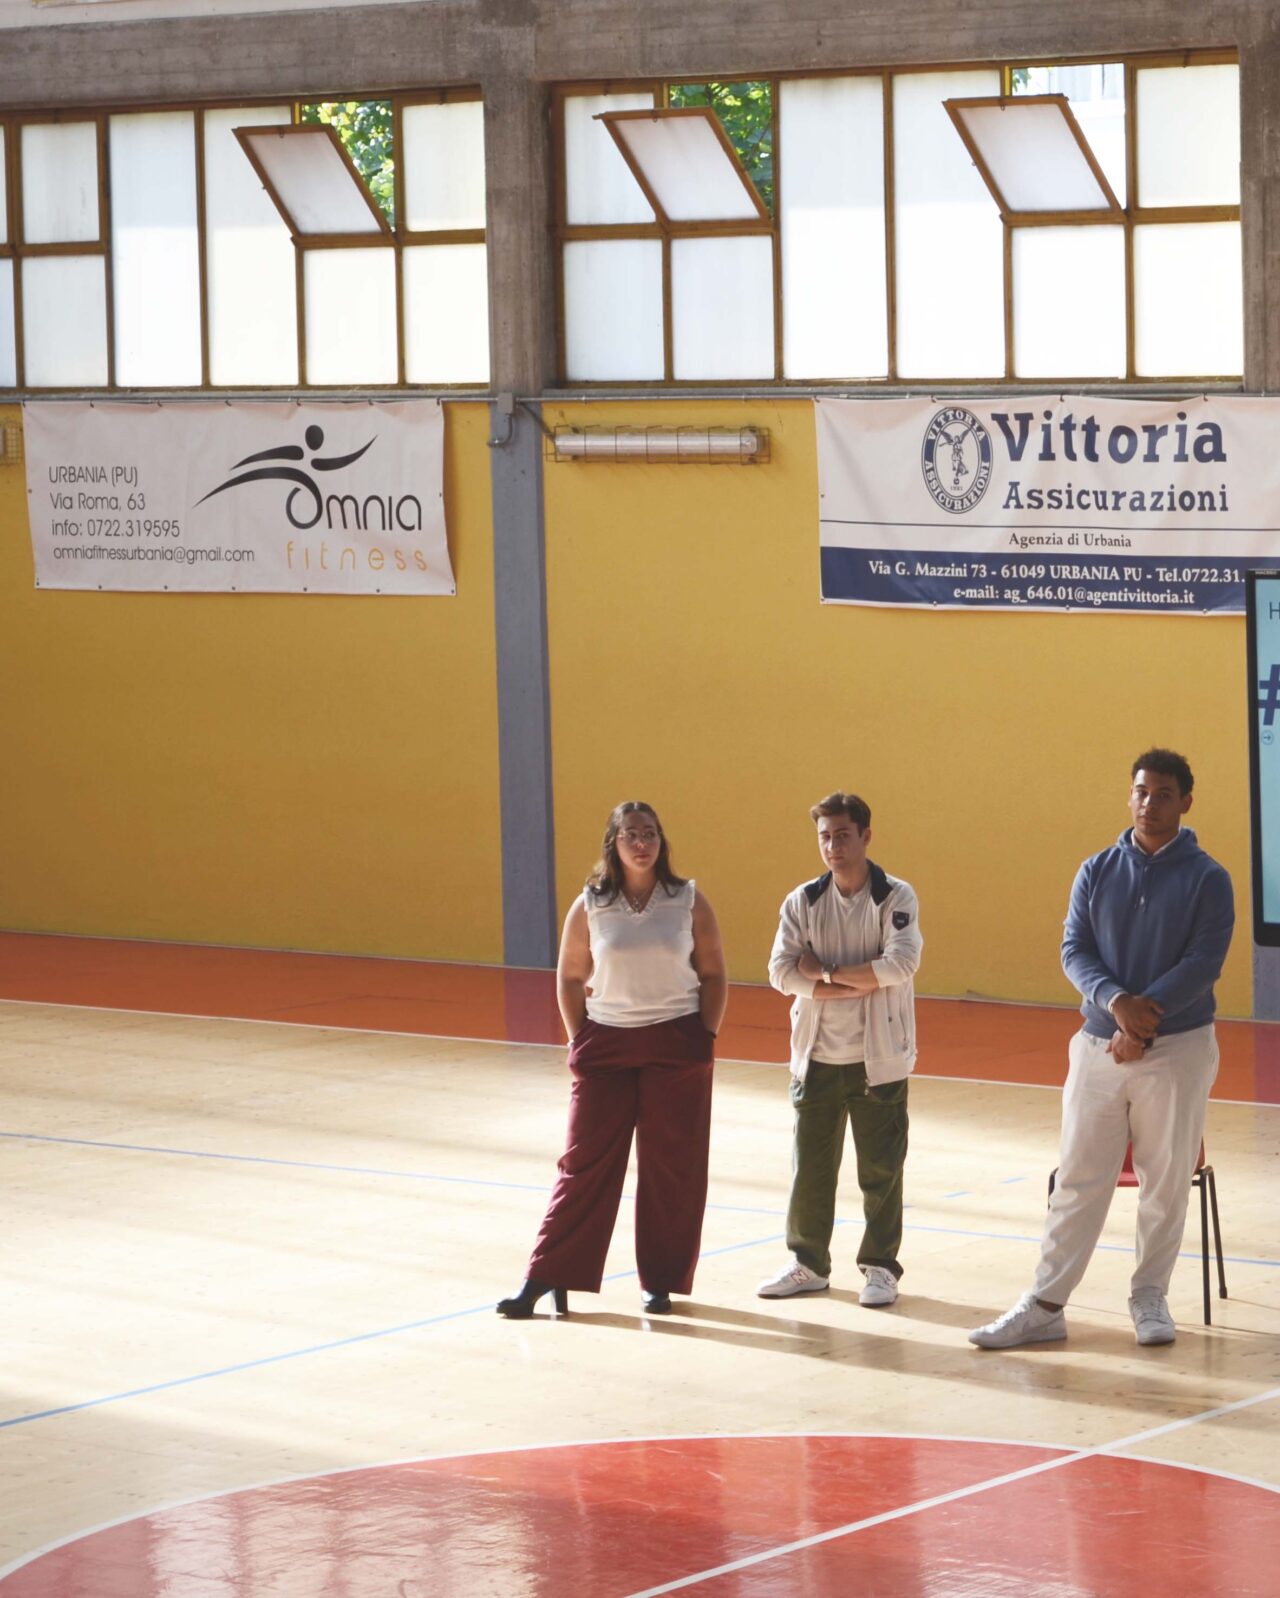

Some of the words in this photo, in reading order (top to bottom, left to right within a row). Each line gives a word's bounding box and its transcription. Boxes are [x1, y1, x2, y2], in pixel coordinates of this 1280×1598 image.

[928, 410, 986, 440] VITTORIA
[990, 409, 1227, 465] Vittoria
[48, 466, 108, 484] URBANIA
[111, 466, 138, 487] (PU)
[925, 461, 990, 510] ASSICURAZIONI
[50, 493, 73, 510] Via
[78, 493, 122, 512] Roma,
[127, 493, 146, 510] 63
[1002, 480, 1229, 513] Assicurazioni
[52, 519, 83, 537] info:
[87, 519, 180, 538] 0722.319595
[1009, 533, 1063, 549] Agenzia
[1067, 533, 1079, 546] di
[1084, 533, 1132, 548] Urbania
[53, 545, 255, 564] omniafitnessurbania@gmail.com
[287, 541, 428, 571] fitness
[869, 561, 891, 575] Via
[895, 562, 910, 576] G.
[915, 563, 968, 578] Mazzini
[971, 565, 987, 578] 73
[1001, 564, 1046, 579] 61049
[1050, 565, 1120, 581] URBANIA
[1123, 567, 1142, 582] PU
[953, 585, 999, 599] e-mail:
[1004, 585, 1196, 605] ag_646.01@agentivittoria.it
